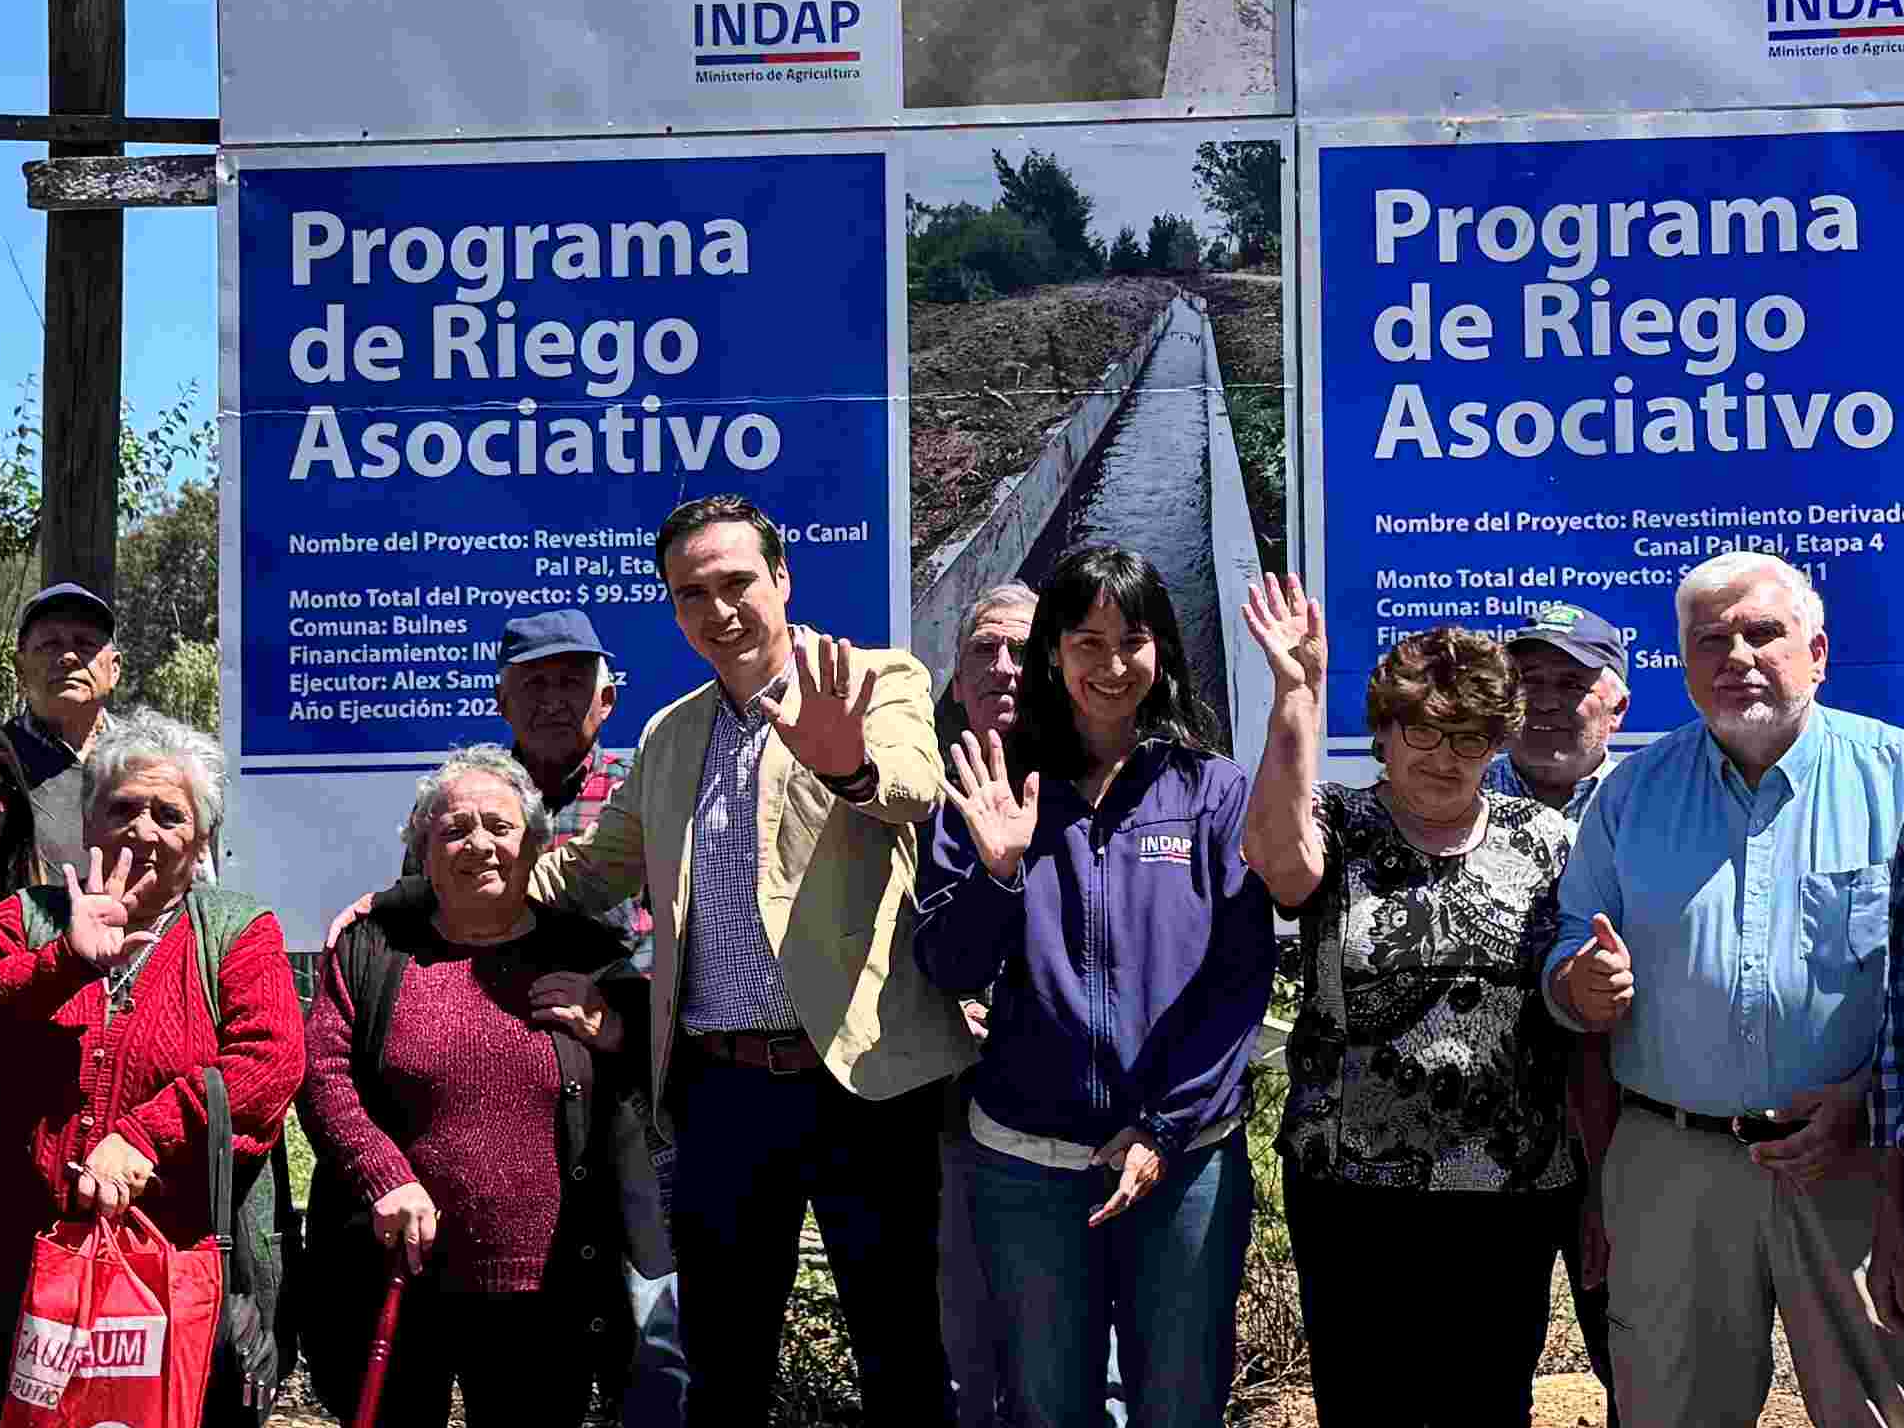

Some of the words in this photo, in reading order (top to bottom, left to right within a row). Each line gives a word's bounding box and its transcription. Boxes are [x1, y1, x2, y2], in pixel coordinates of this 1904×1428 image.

[694, 0, 860, 48] INDAP
[1768, 43, 1839, 58] Ministerio
[1842, 43, 1859, 55] de
[695, 68, 765, 84] Ministerio
[766, 68, 784, 82] de
[786, 67, 860, 84] Agricultura
[1375, 188, 1859, 282] Programa
[292, 210, 749, 304] Programa
[1373, 282, 1493, 362] de
[1523, 278, 1806, 376] Riego
[289, 303, 404, 384] de
[433, 300, 699, 398] Riego
[1374, 372, 1894, 459] Asociativo
[287, 394, 781, 480] Asociativo
[1375, 512, 1469, 533] Nombre
[1474, 511, 1510, 532] del
[1516, 511, 1627, 536] Proyecto:
[1631, 506, 1802, 529] Revestimiento
[288, 532, 379, 554] Nombre
[383, 530, 418, 552] del
[423, 531, 529, 555] Proyecto:
[534, 526, 660, 549] Revestimie
[805, 520, 868, 543] Canal
[1633, 535, 1700, 557] Canal
[1705, 534, 1742, 554] Pal
[1747, 532, 1790, 556] Pal,
[1796, 533, 1864, 557] Etapa
[1869, 532, 1885, 551] 4
[535, 555, 569, 577] Pal
[575, 555, 615, 578] Pal,
[620, 555, 662, 580] Eta
[1376, 569, 1453, 590] Monto
[1455, 567, 1514, 589] Total
[1519, 566, 1555, 588] del
[1561, 566, 1673, 591] Proyecto:
[288, 589, 362, 609] Monto
[365, 586, 421, 608] Total
[425, 585, 460, 606] del
[466, 586, 572, 610] Proyecto:
[576, 583, 590, 605] $
[1376, 597, 1480, 618] Comuna:
[1485, 595, 1563, 617] Buln
[289, 617, 388, 637] Comuna:
[393, 613, 468, 635] Bulnes
[289, 643, 468, 665] Financiamiento:
[289, 672, 387, 698] Ejecutor:
[391, 669, 441, 690] Alex
[446, 669, 502, 689] Sam
[289, 700, 334, 721] Año
[339, 697, 452, 725] Ejecución:
[457, 697, 503, 717] 202
[1140, 835, 1193, 853] INDAP
